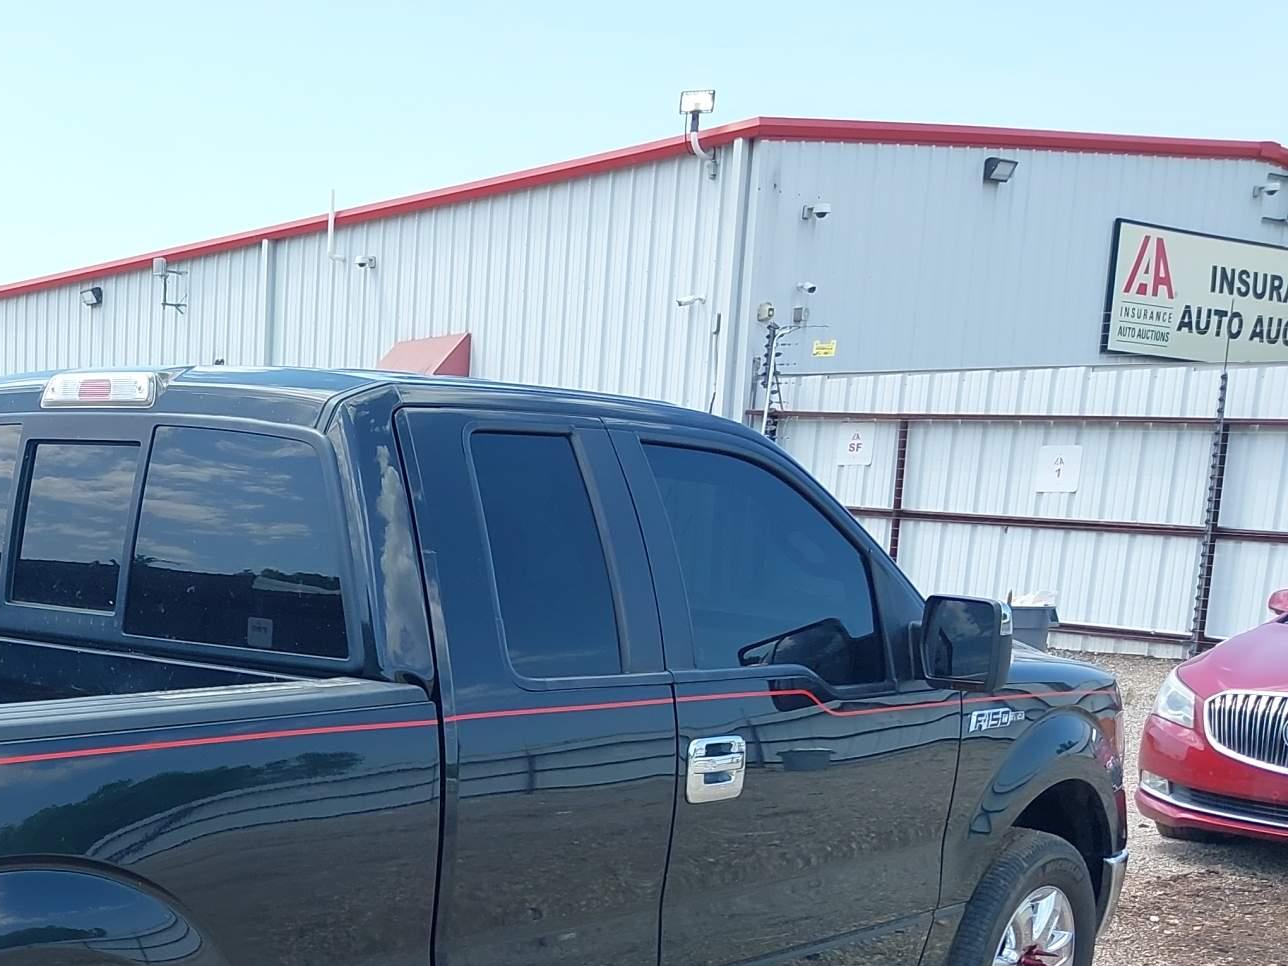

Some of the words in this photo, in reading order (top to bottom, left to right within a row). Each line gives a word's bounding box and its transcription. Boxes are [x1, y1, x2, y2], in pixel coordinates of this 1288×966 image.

[1119, 306, 1173, 323] INSURANCE
[1176, 305, 1243, 339] AUTO
[1117, 326, 1136, 338] AUTO
[1136, 327, 1170, 343] AUCTIONS
[848, 442, 863, 452] SF
